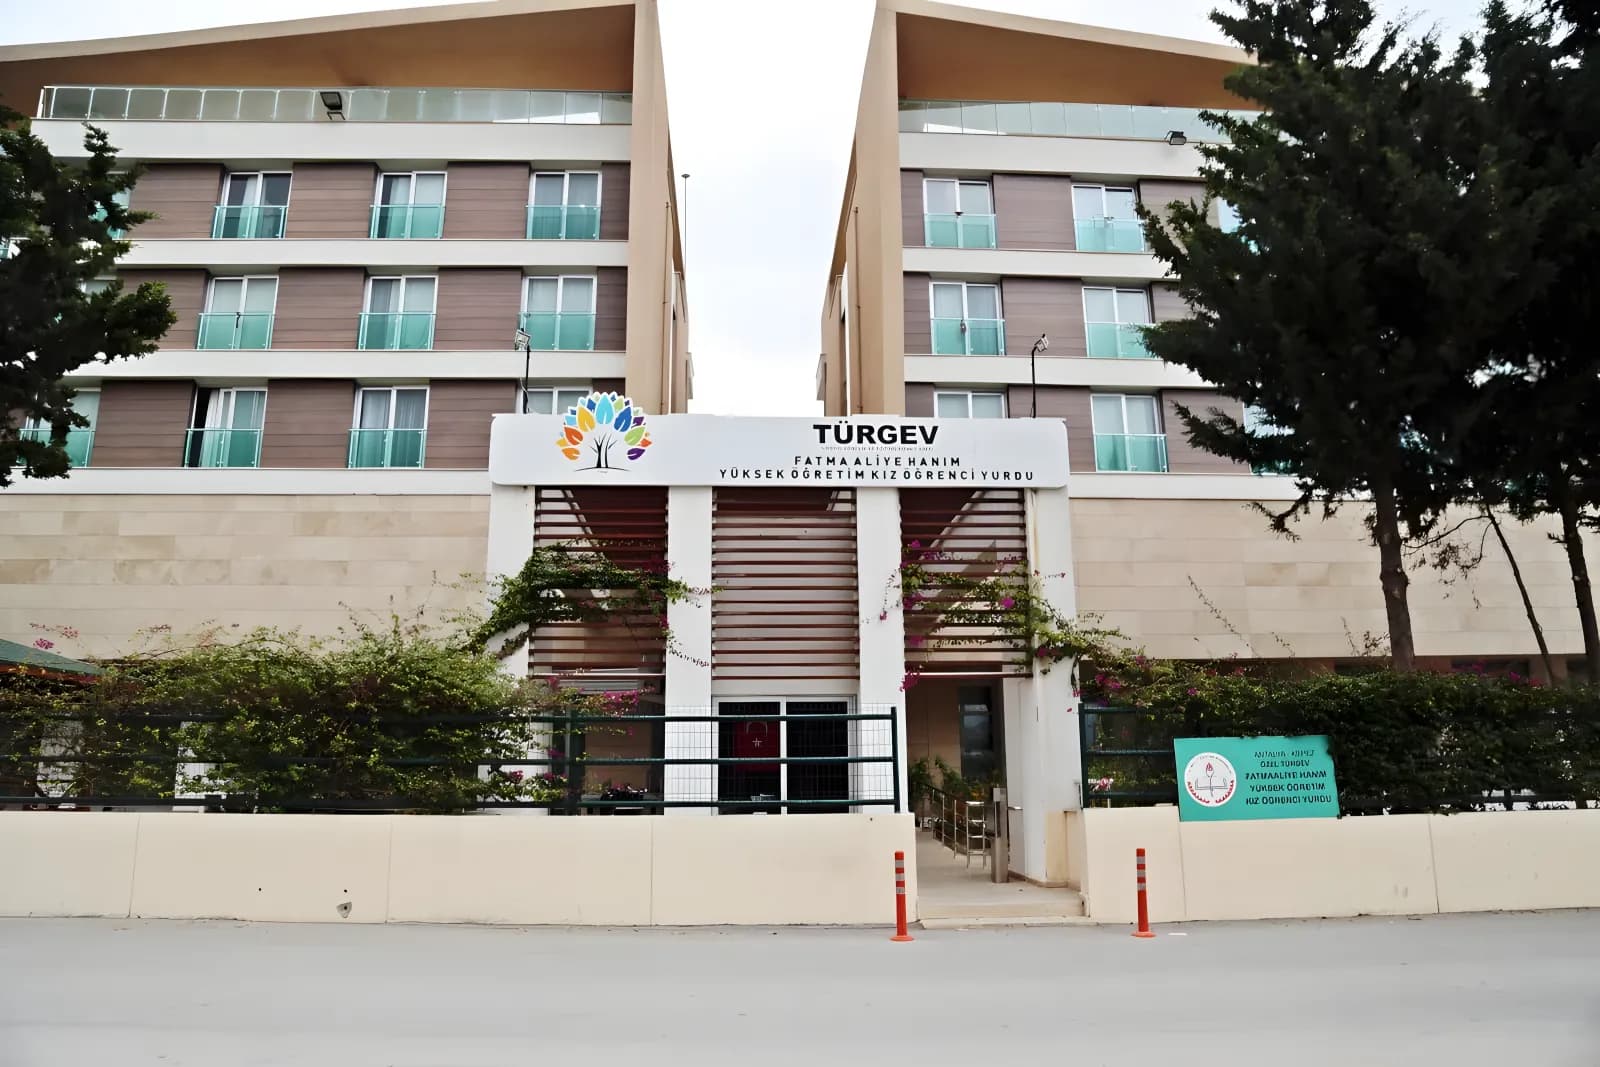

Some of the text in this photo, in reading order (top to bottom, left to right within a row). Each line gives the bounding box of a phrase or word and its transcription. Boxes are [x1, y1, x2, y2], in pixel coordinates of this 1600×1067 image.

[813, 420, 939, 444] TÜRGEV
[795, 454, 960, 467] FATMA ALİYE HANIM
[720, 467, 1033, 481] YÜKSEK ÖĞRETİM KIZ ÖĞRENCİ YURDU
